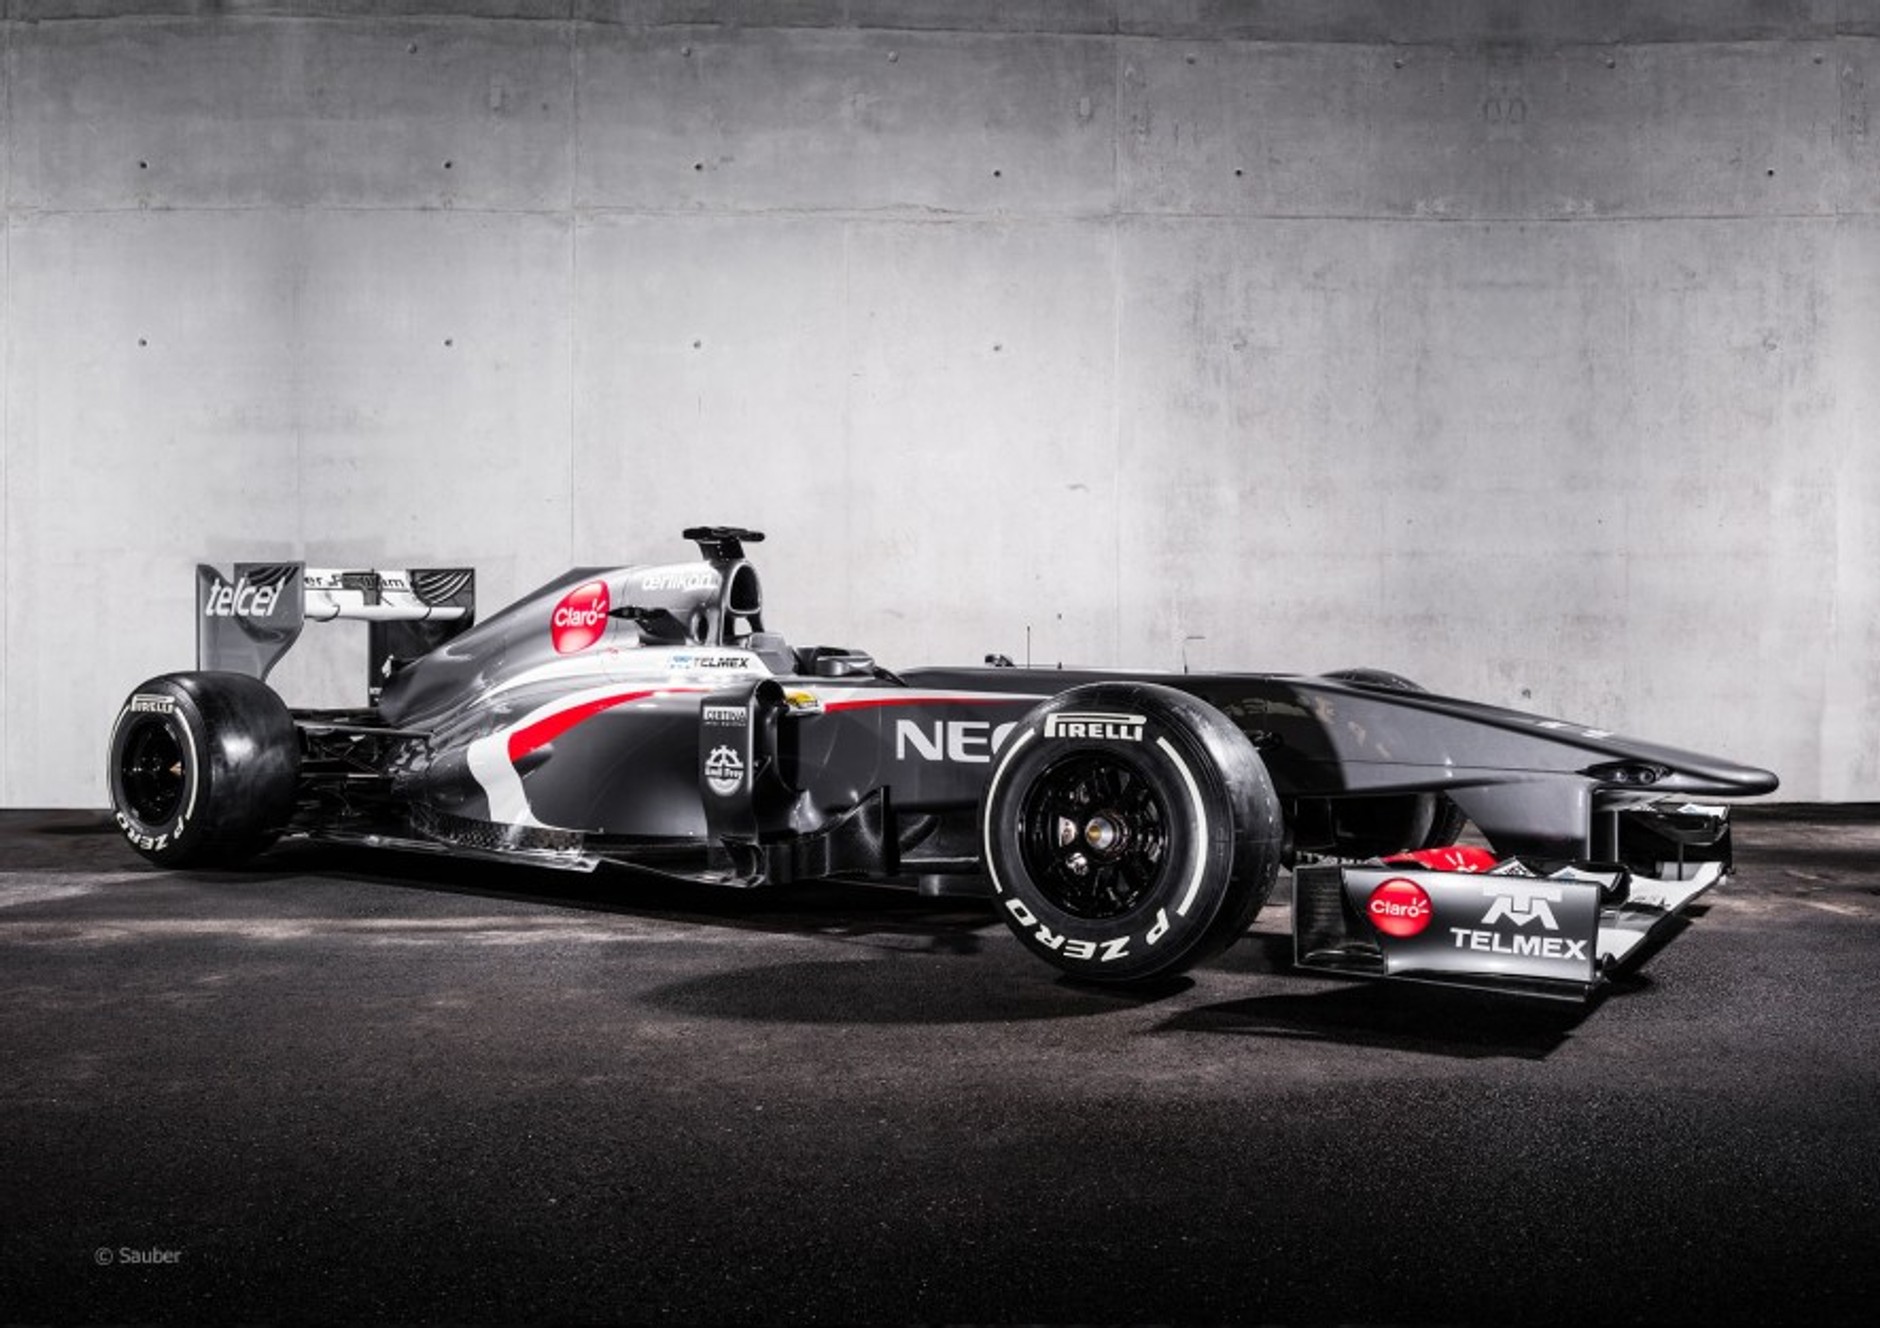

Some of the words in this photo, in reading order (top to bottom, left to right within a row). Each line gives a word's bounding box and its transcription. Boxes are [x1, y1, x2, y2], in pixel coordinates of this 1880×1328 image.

[205, 577, 285, 616] telcel
[554, 604, 599, 627] Claro
[131, 693, 175, 713] PIRELLI
[1043, 712, 1147, 742] PIRELLI
[116, 812, 169, 851] ZERO
[1370, 898, 1421, 918] Claro
[1005, 898, 1130, 962] ZERO
[1449, 927, 1588, 961] TELMEX
